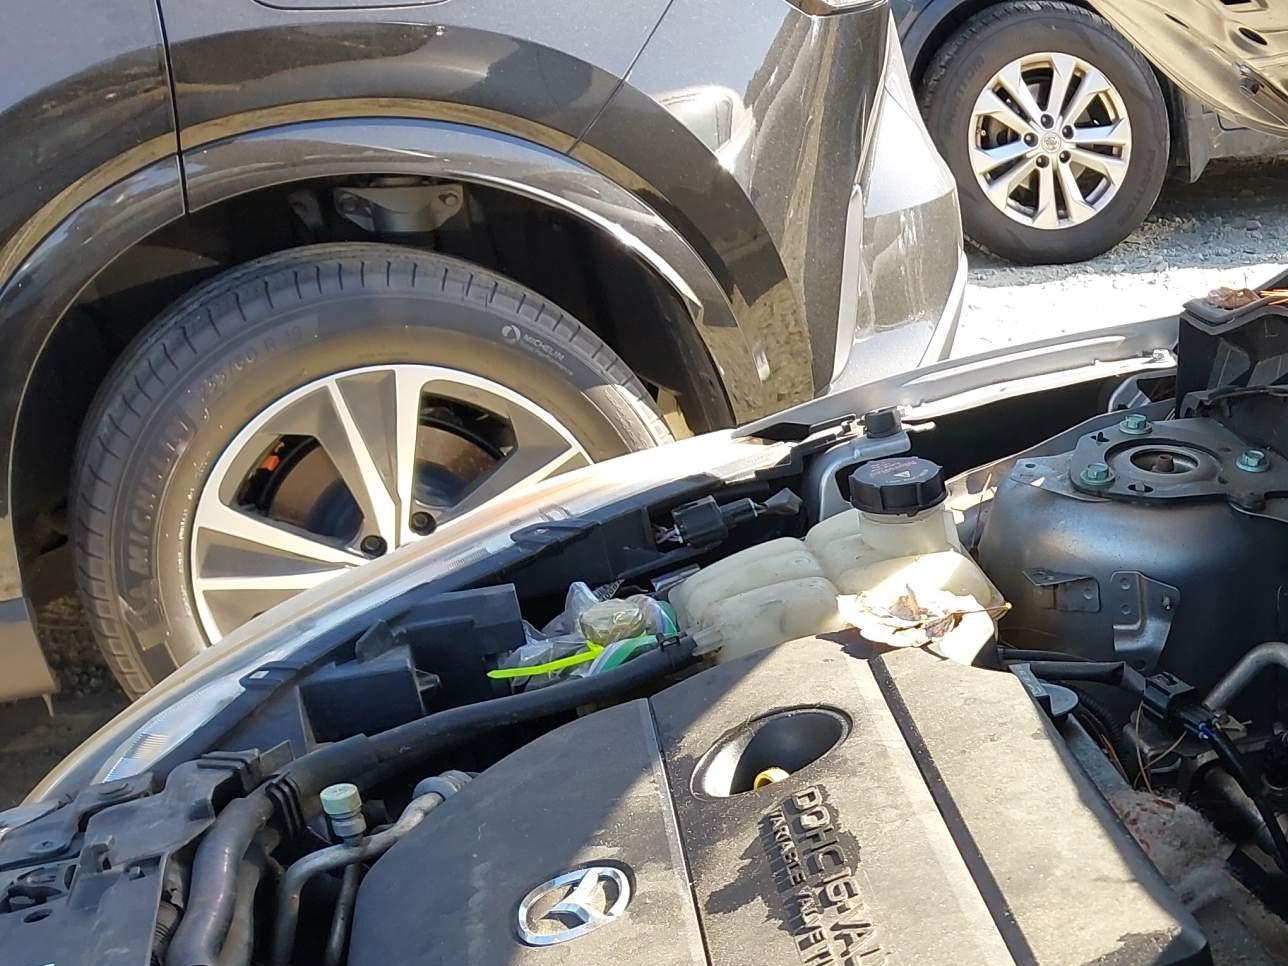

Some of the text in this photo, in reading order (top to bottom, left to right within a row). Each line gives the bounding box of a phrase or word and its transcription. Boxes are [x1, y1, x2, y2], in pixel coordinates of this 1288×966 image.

[763, 804, 807, 887] VARIABLE
[792, 885, 826, 949] VALVE
[785, 785, 847, 874] DOHC
